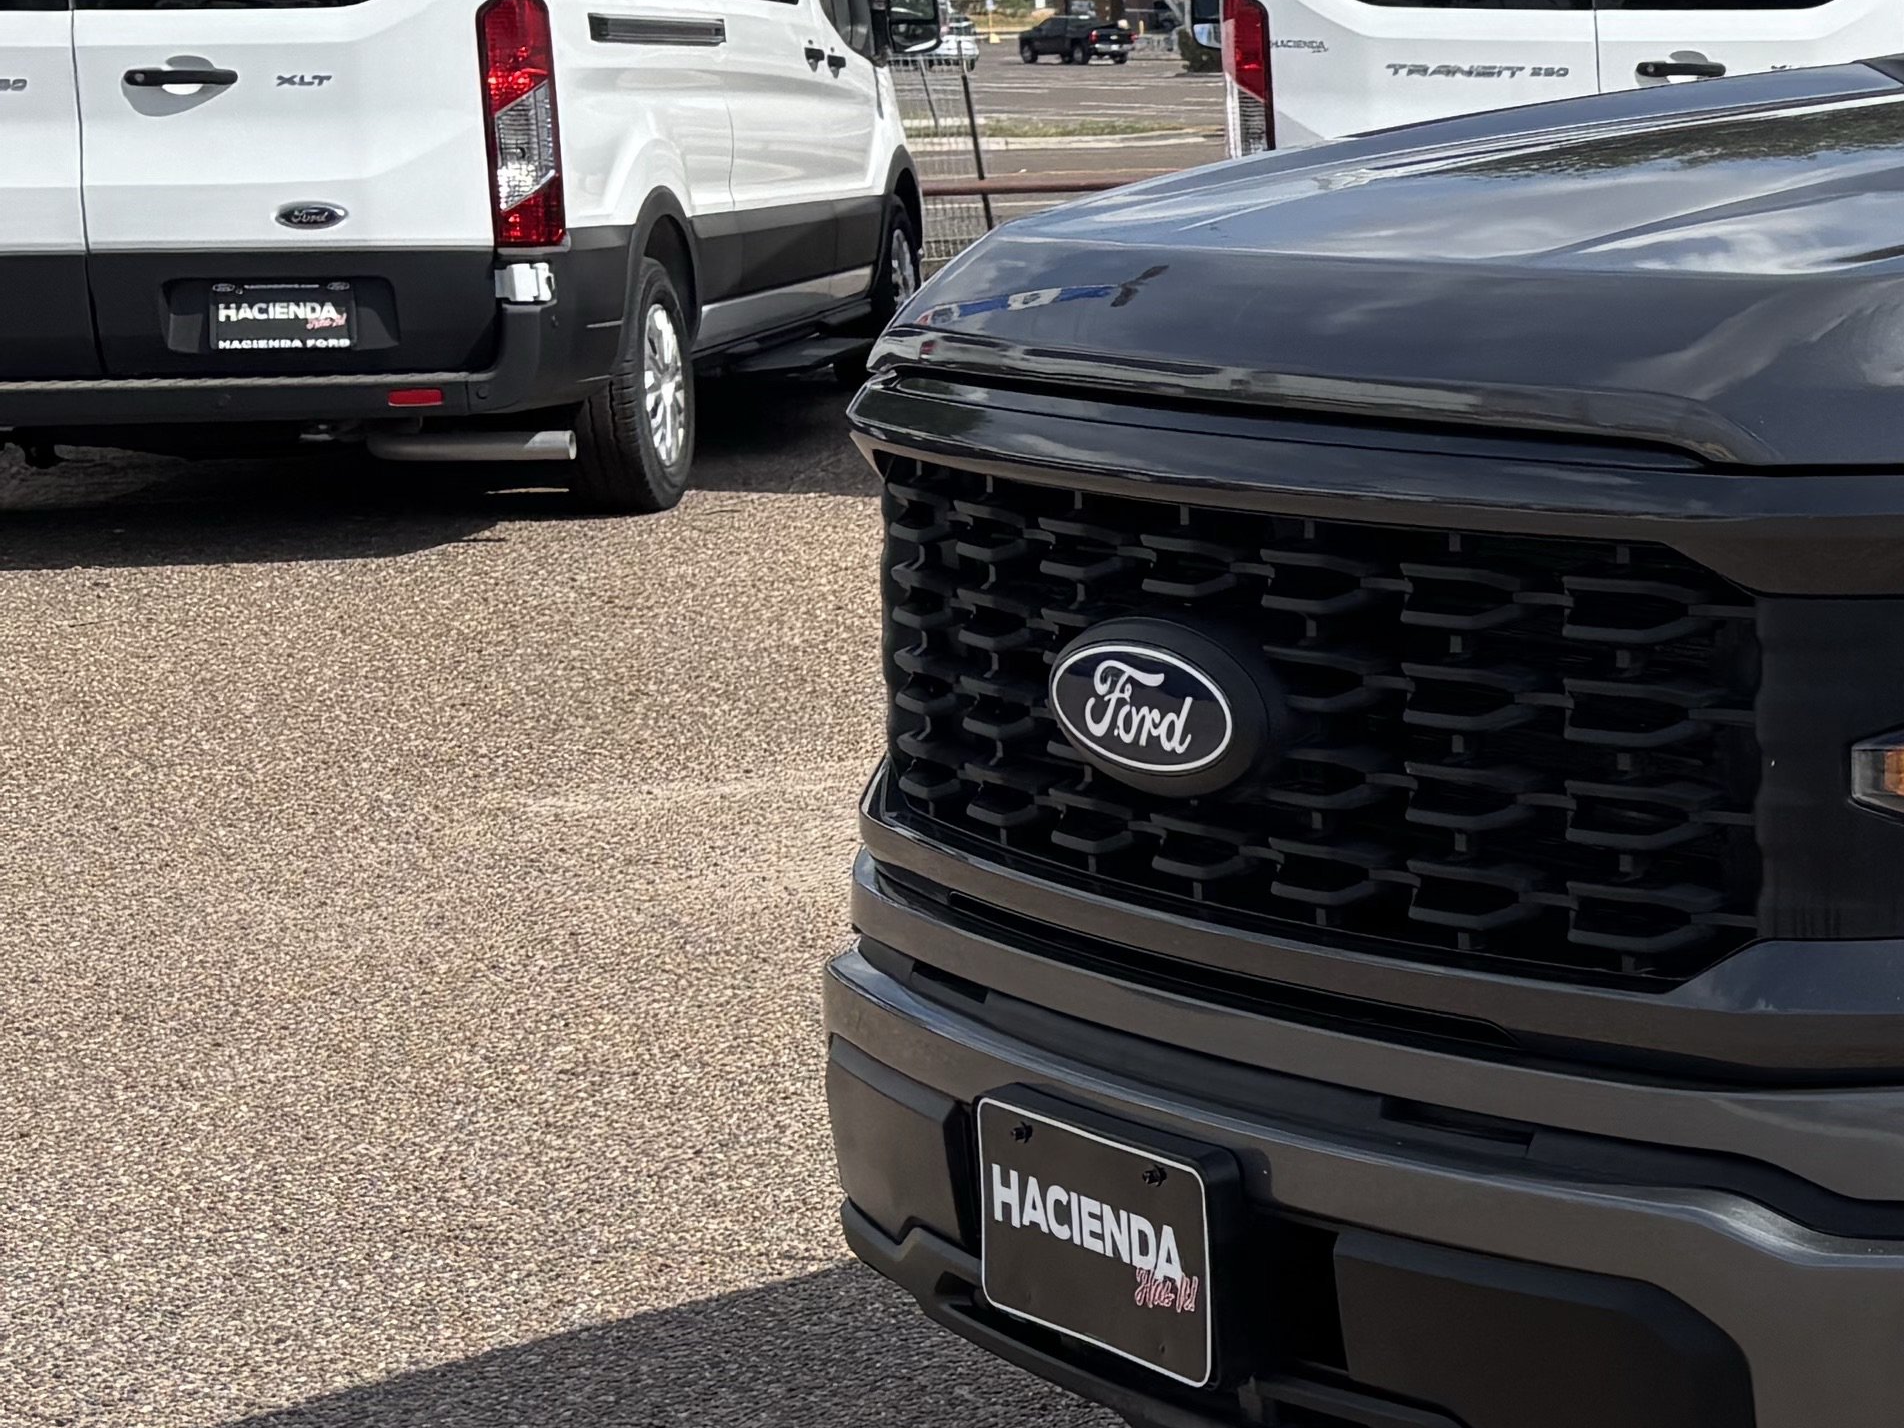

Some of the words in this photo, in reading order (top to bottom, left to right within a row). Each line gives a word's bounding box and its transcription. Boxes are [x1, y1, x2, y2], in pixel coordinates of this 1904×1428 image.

[1386, 63, 1525, 79] TRANSIT
[276, 74, 333, 88] XLT
[290, 208, 329, 224] Ford
[218, 301, 338, 322] HACIENDA
[218, 339, 304, 350] HACIENDA
[306, 338, 351, 349] FORD
[1085, 659, 1194, 755] Ford
[991, 1163, 1184, 1288] HACIENDA
